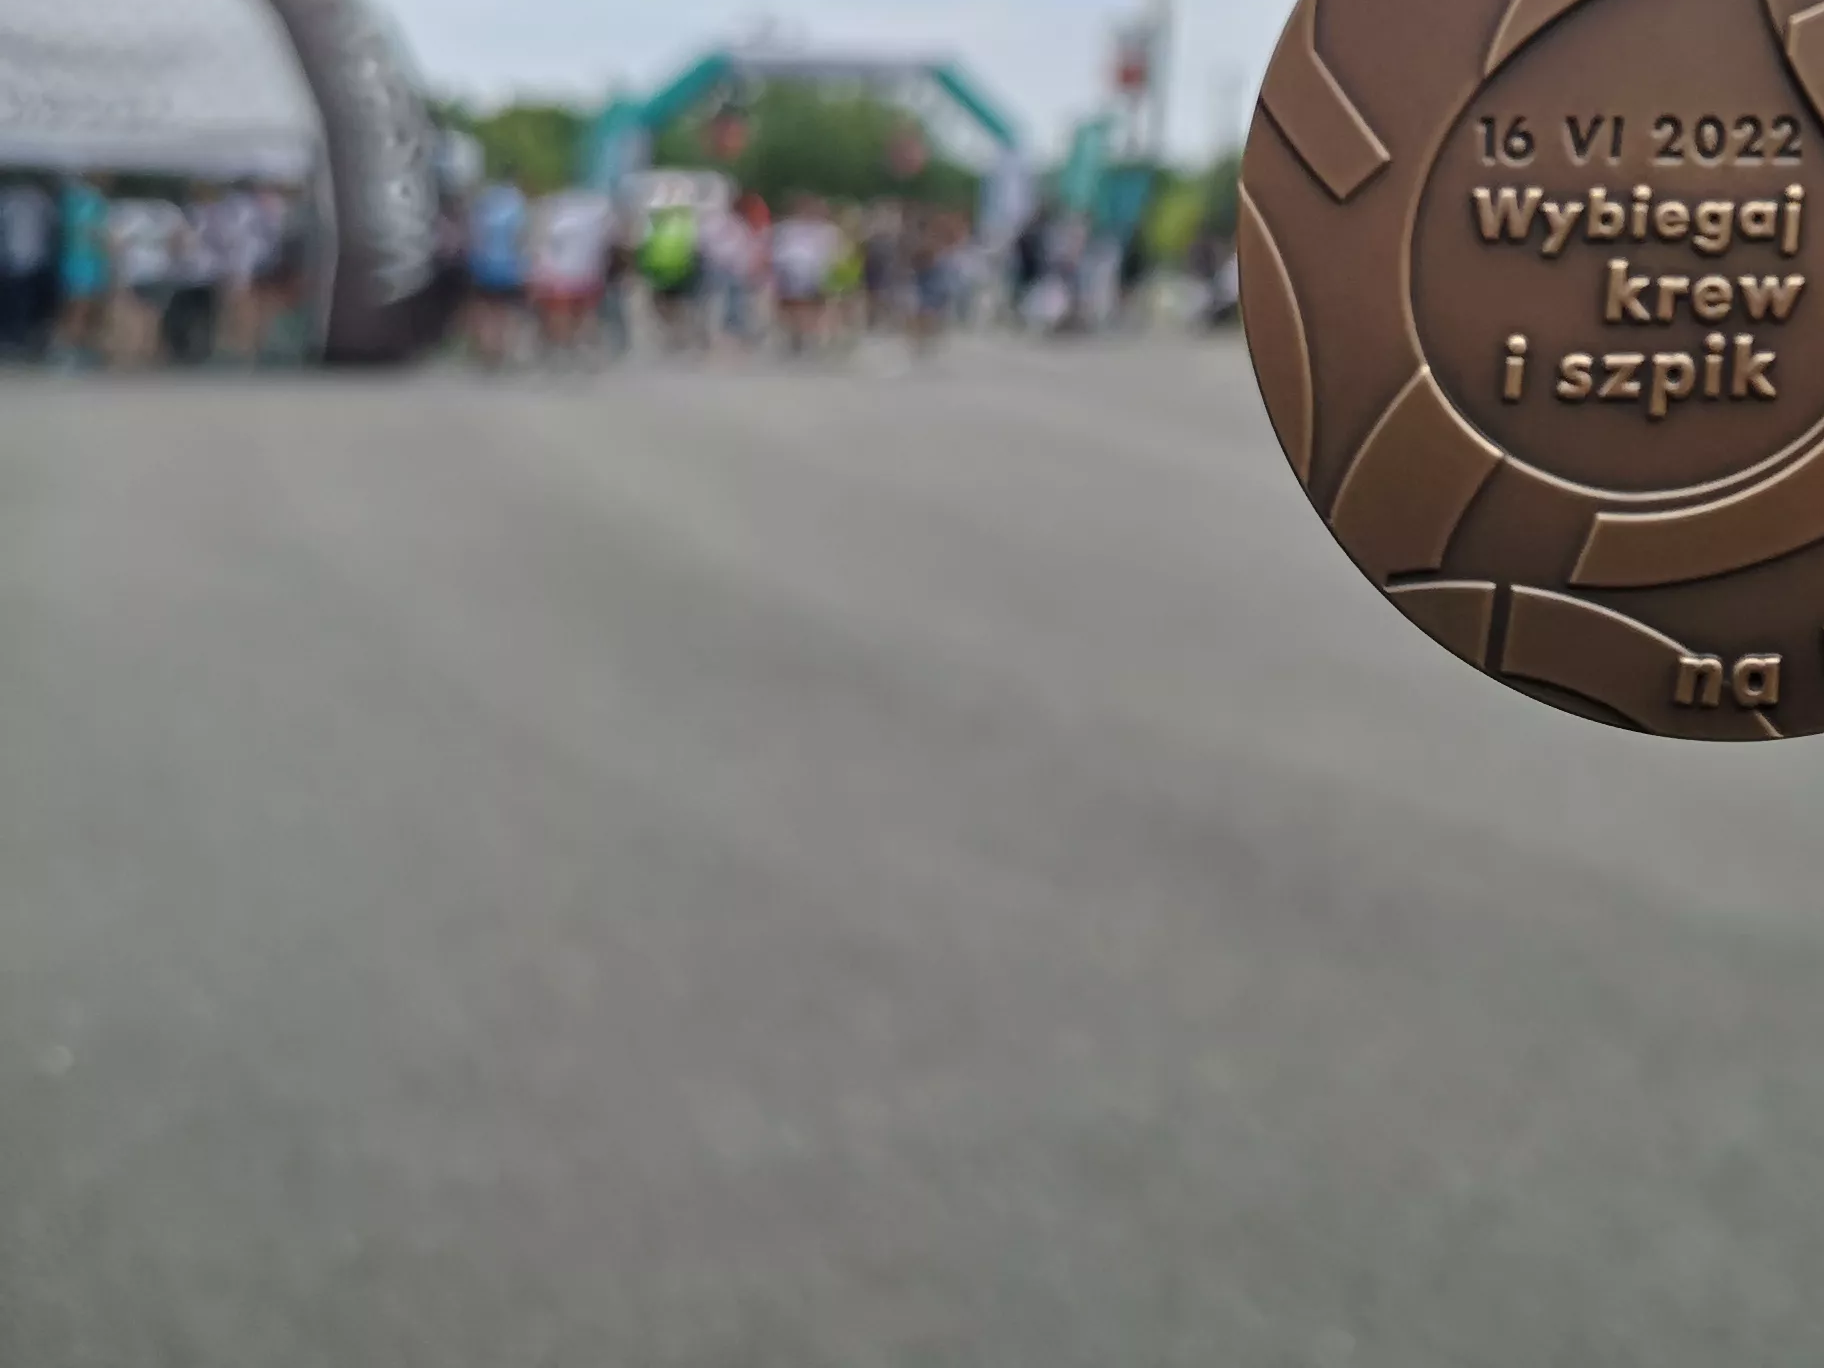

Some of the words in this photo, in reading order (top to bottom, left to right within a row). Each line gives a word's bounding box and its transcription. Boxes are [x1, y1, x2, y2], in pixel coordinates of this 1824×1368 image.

[1474, 115, 1537, 167] 16
[1564, 115, 1626, 167] VI
[1652, 114, 1803, 167] 2022
[1472, 183, 1805, 256] Wybiegaj
[1604, 258, 1805, 322] krew
[1502, 334, 1528, 400] i
[1556, 333, 1776, 418] szpik
[1674, 653, 1782, 707] na
